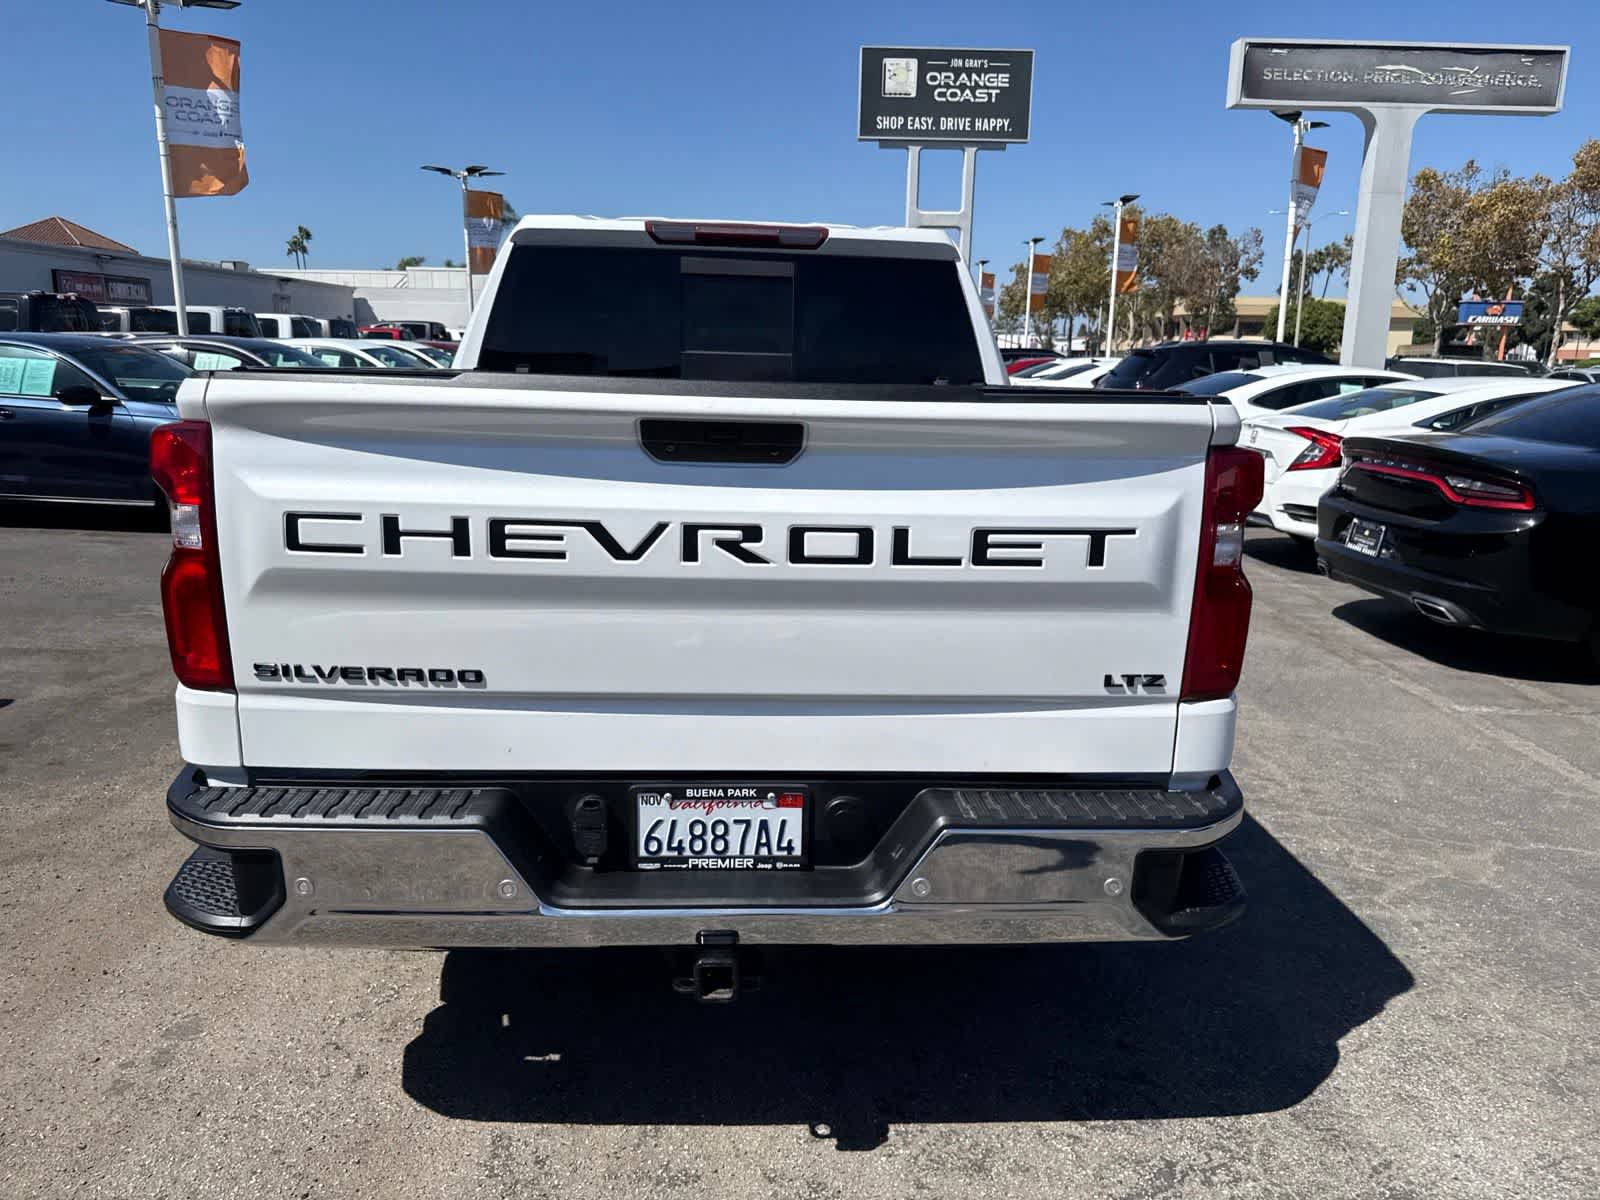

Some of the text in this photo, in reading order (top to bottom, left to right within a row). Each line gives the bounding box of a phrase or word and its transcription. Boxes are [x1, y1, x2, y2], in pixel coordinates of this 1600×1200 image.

[950, 59, 988, 68] JON GRAY'S
[926, 72, 1010, 87] ORANGE
[934, 88, 1000, 102] COAST
[876, 116, 1012, 131] SHOP EASY. DRIVE HAPPY.
[284, 511, 1137, 568] CHEVROLET
[253, 663, 484, 686] SILVERADO
[1104, 674, 1165, 689] LTZ
[641, 794, 661, 806] NOV
[686, 789, 757, 798] BUENA PARK
[669, 798, 764, 816] California
[644, 818, 795, 856] 64887A4
[689, 858, 754, 869] PREMIER
